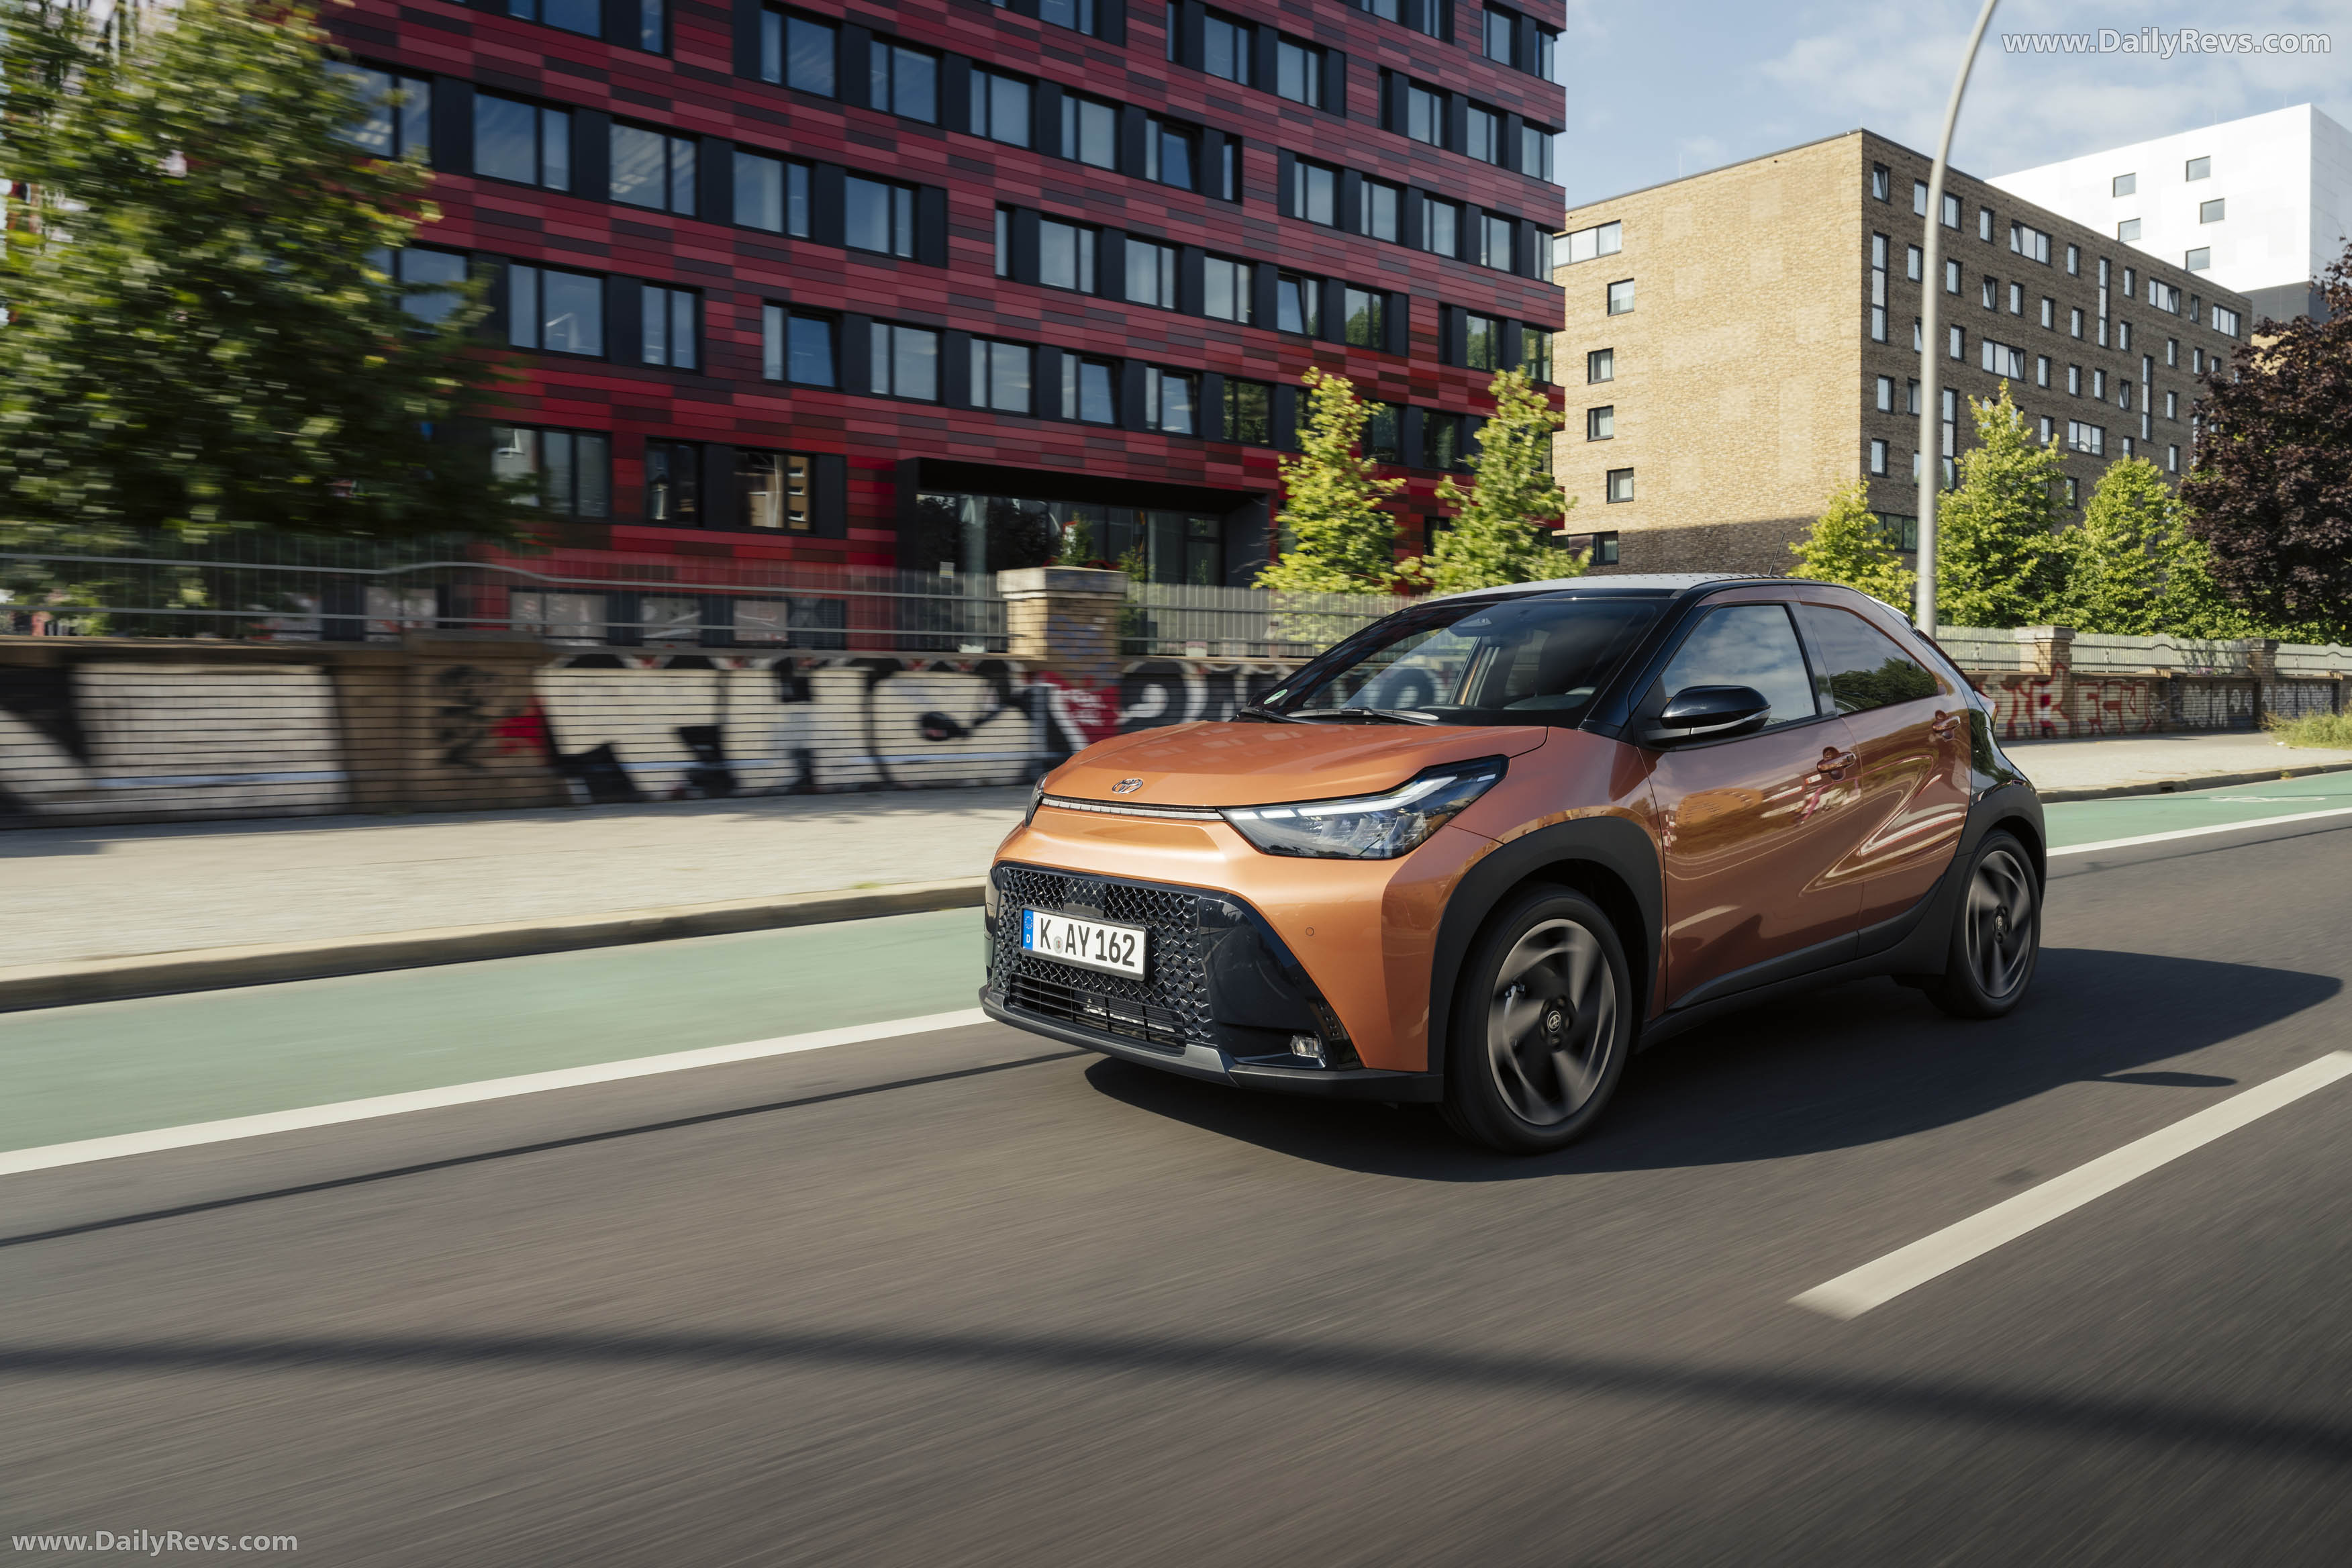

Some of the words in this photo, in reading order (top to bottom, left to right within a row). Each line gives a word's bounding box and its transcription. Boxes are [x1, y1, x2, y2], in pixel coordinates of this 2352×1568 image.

[1026, 934, 1030, 943] D
[1040, 918, 1051, 950] K
[1065, 923, 1090, 957] AY
[1095, 929, 1135, 967] 162
